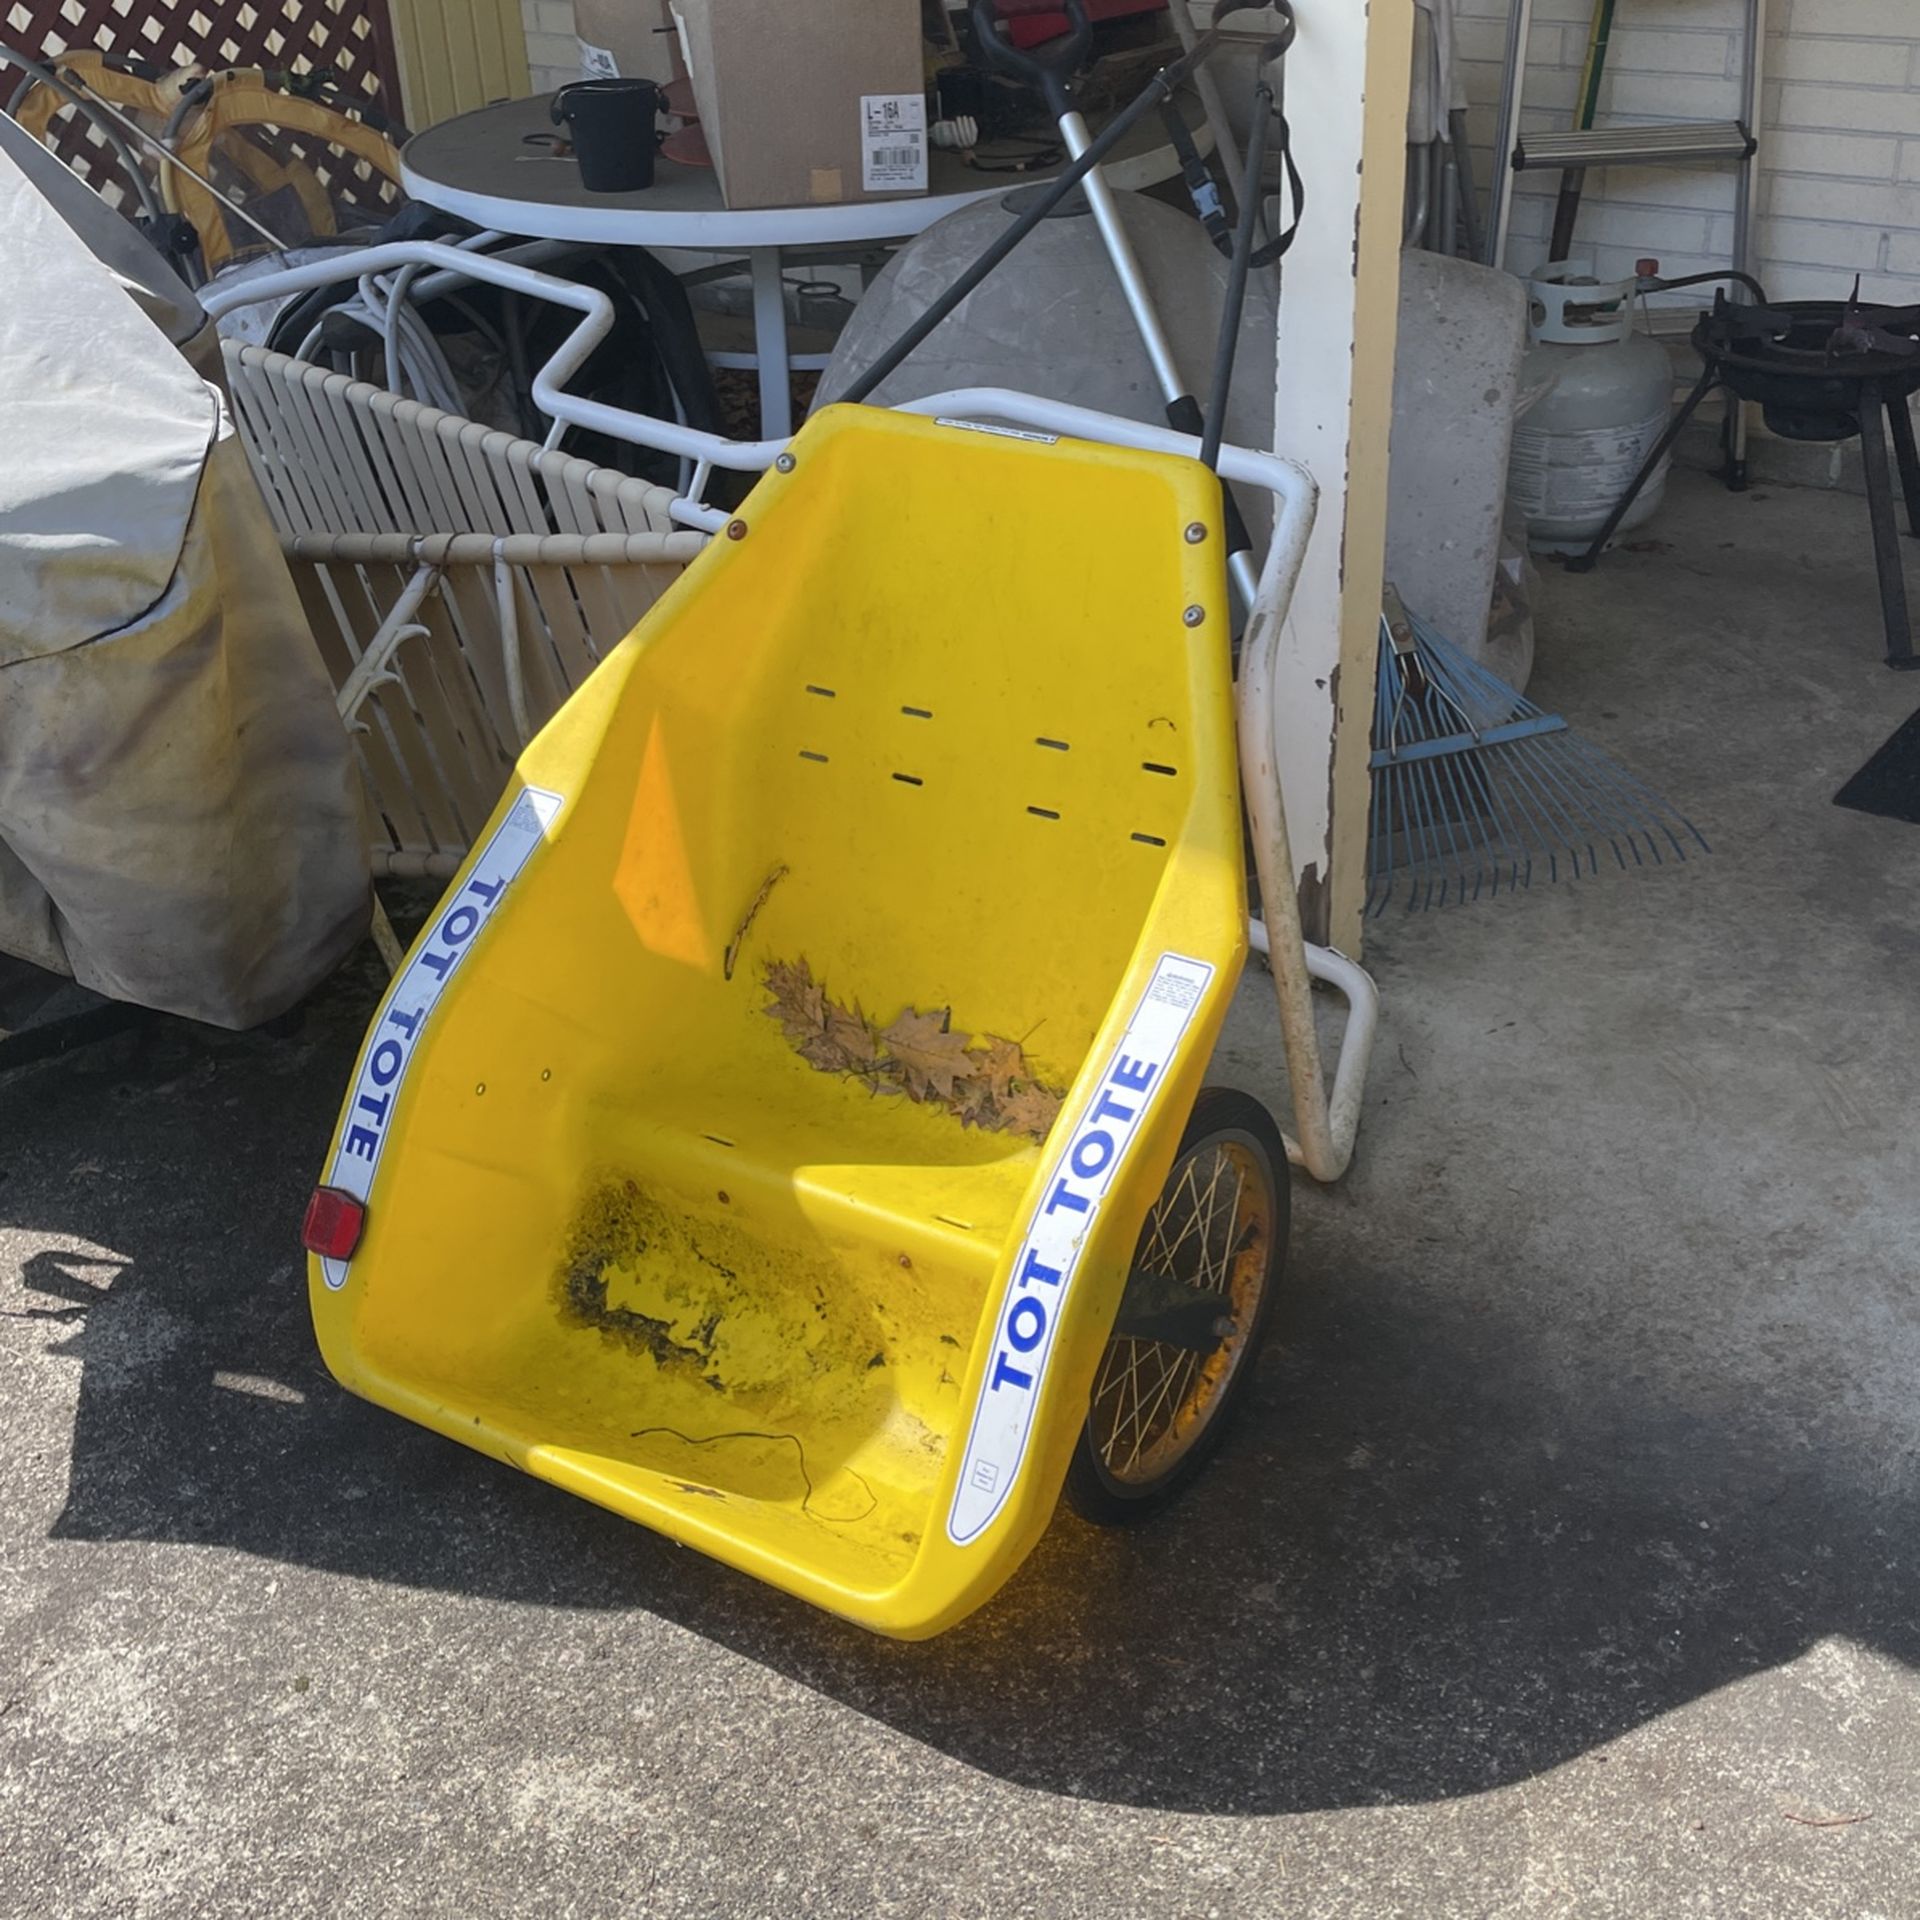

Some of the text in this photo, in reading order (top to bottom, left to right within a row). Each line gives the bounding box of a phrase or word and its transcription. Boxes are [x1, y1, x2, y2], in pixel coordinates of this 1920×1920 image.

[345, 878, 505, 1162] TOT TOTE
[991, 1054, 1158, 1392] TOT TOTE
